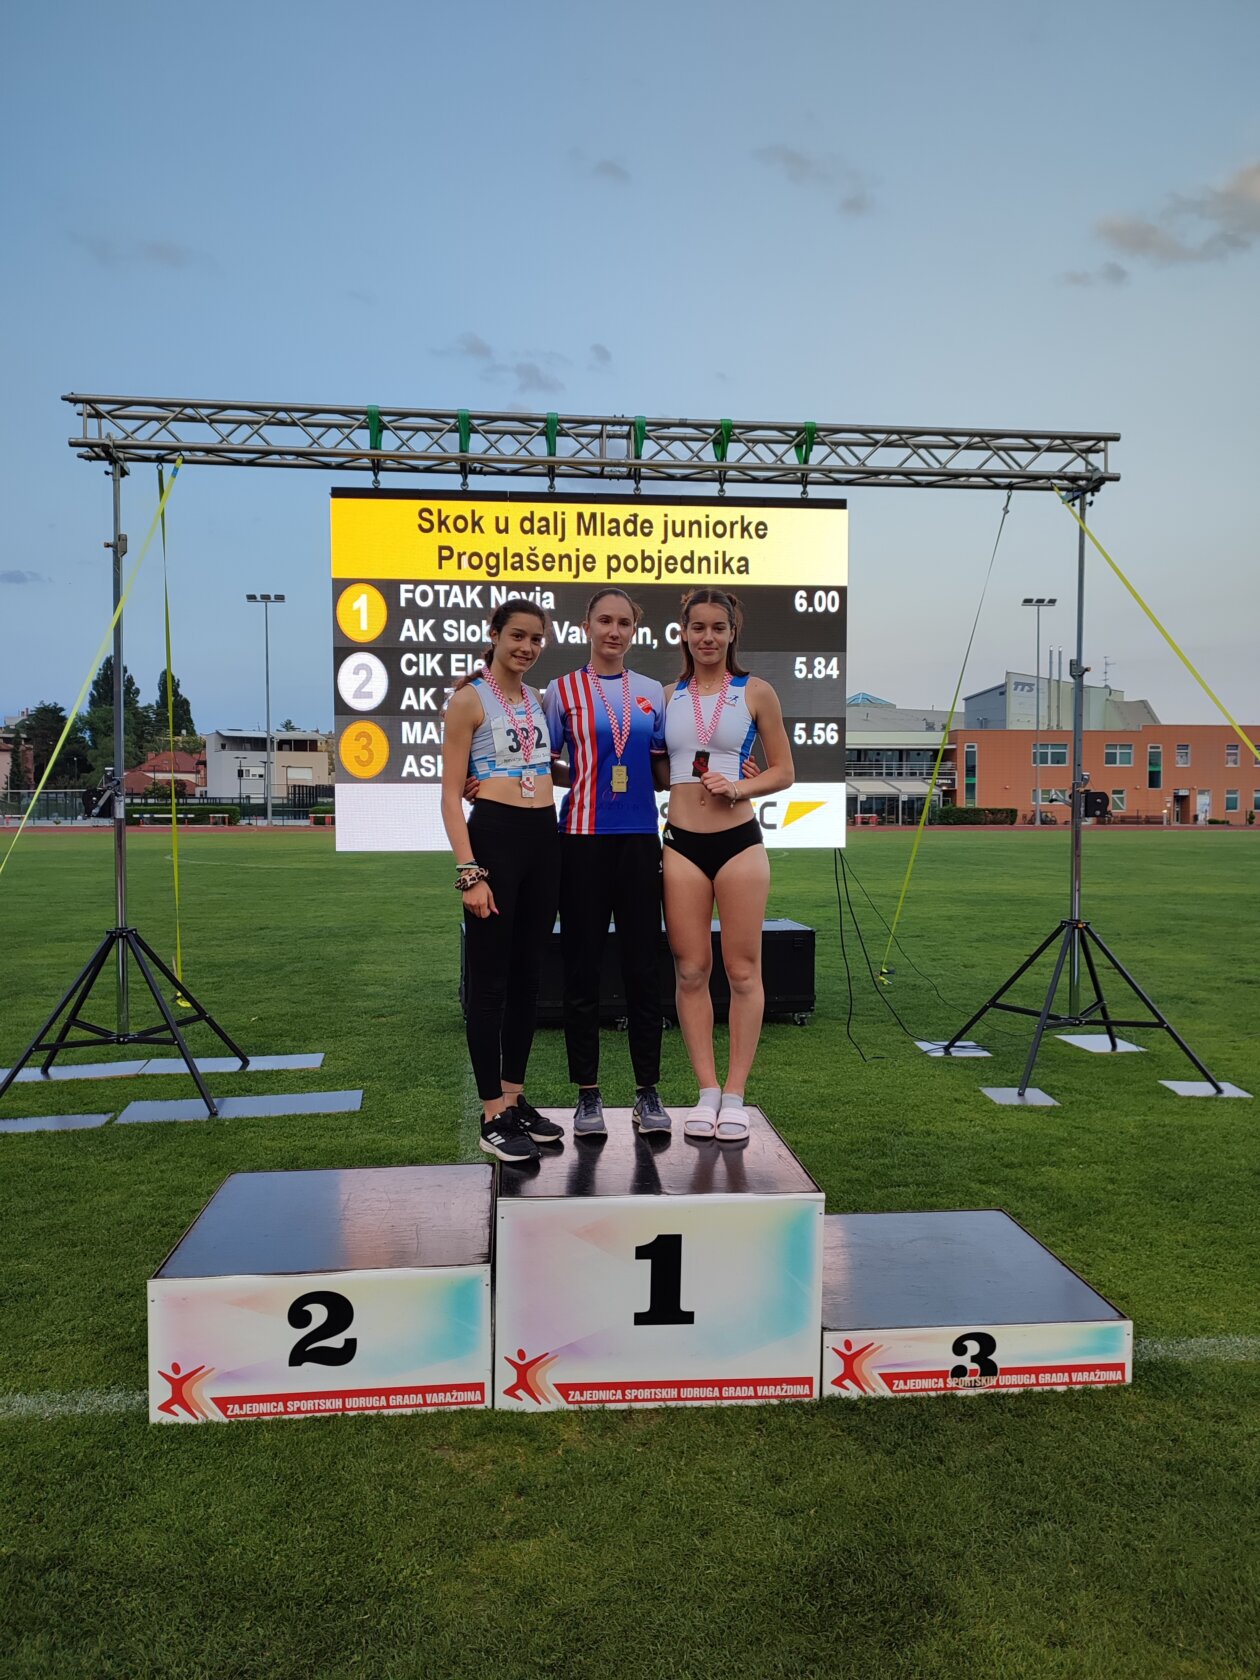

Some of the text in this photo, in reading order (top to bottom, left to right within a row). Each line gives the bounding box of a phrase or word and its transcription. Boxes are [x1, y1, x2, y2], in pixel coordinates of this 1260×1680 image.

[418, 507, 768, 544] Skok u dalj Mlađe juniorke
[438, 545, 750, 580] Proglašenje pobjednika
[399, 584, 483, 608] FOTAK
[794, 590, 839, 613] 6.00
[352, 593, 368, 631] 1
[399, 618, 437, 642] AK
[400, 653, 444, 677] CIK
[794, 657, 839, 679] 5.84
[352, 663, 373, 699] 2
[400, 687, 438, 710] AK
[402, 721, 445, 744] MA
[794, 722, 839, 745] 5.56
[354, 731, 374, 767] 3
[633, 1233, 695, 1326] 1
[287, 1290, 357, 1367] 2
[951, 1331, 998, 1388] 3
[892, 1378, 944, 1391] ZAJEDNICA
[999, 1374, 1036, 1386] UDRUGA
[1038, 1373, 1069, 1384] GRADA
[1071, 1369, 1122, 1382] VARAŽDINA
[226, 1390, 481, 1416] ZAJEDNICA SPORTSKIH UDRUGA GRADA VARAŽDINA
[568, 1383, 810, 1402] ZAJEDNICA SPORTSKIH UDRUGA GRADA VARAŽDINA
